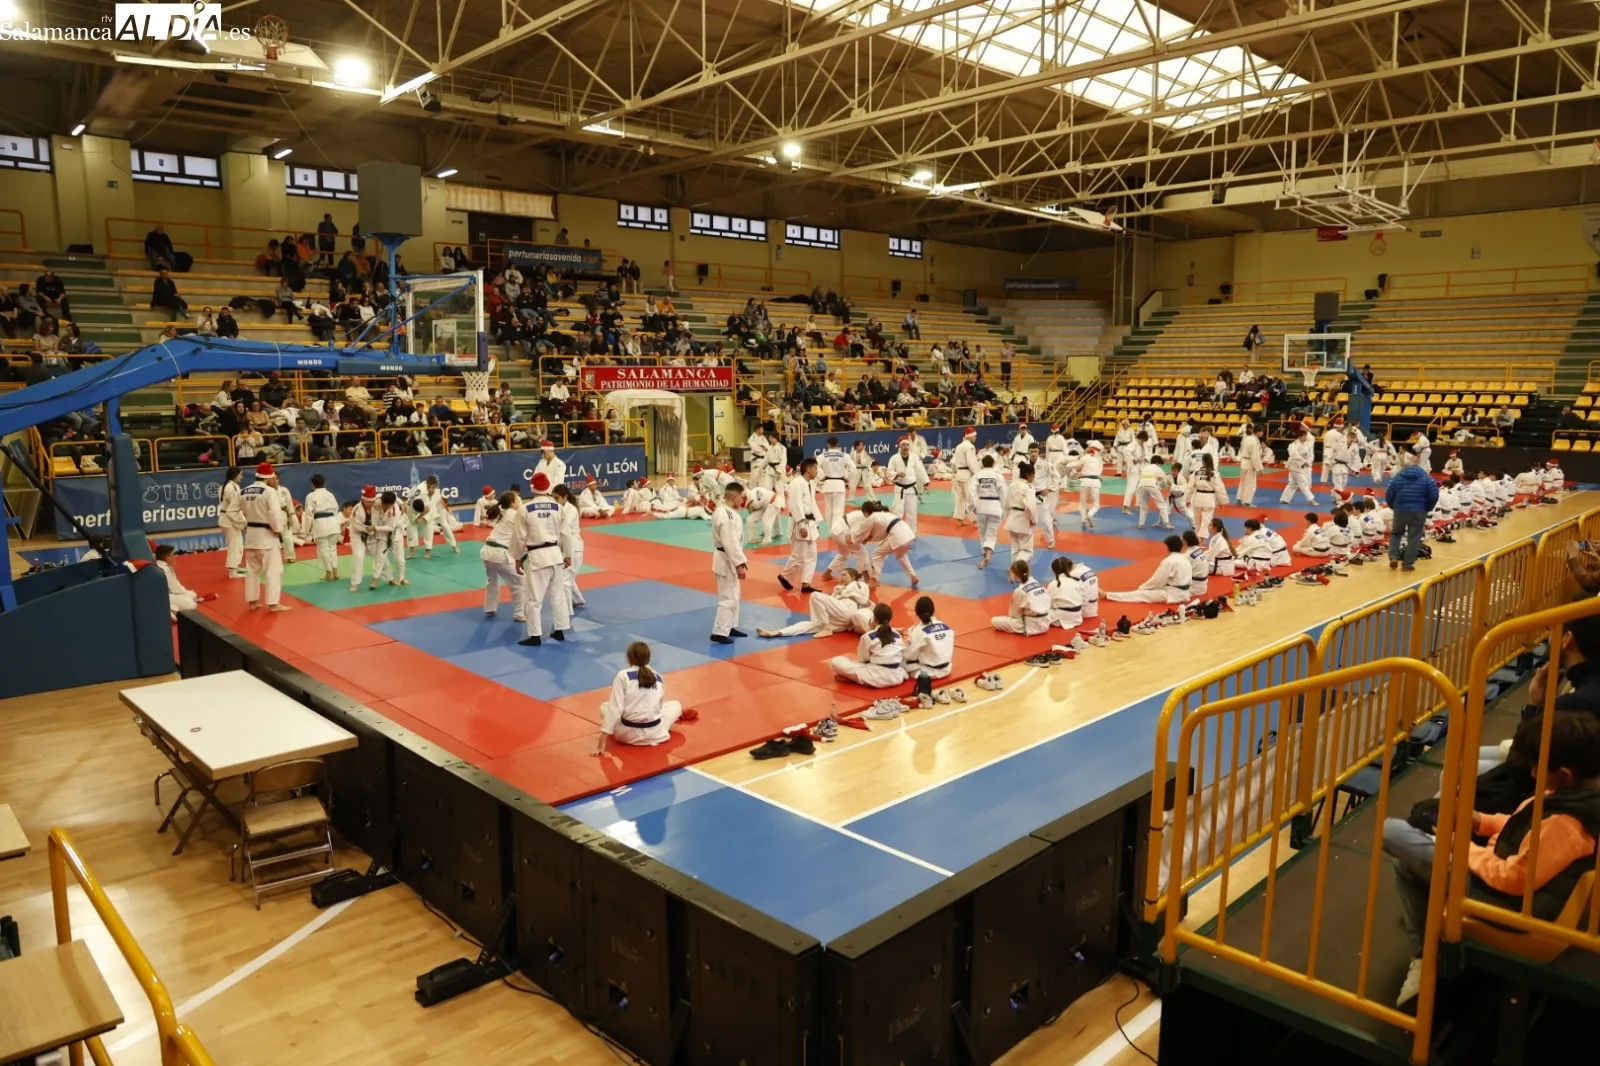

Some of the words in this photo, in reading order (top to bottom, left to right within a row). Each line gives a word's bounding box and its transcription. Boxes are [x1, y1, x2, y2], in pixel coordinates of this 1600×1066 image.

[617, 368, 717, 379] SALAMANCA
[600, 380, 655, 389] PATRIMONIO
[656, 380, 669, 389] DE
[670, 380, 680, 389] LA
[682, 379, 729, 389] HUMANIDAD
[868, 441, 890, 454] LEÓN
[592, 464, 602, 478] Y
[606, 458, 638, 474] LEÓN
[375, 484, 402, 493] turismo
[934, 633, 947, 641] ESP
